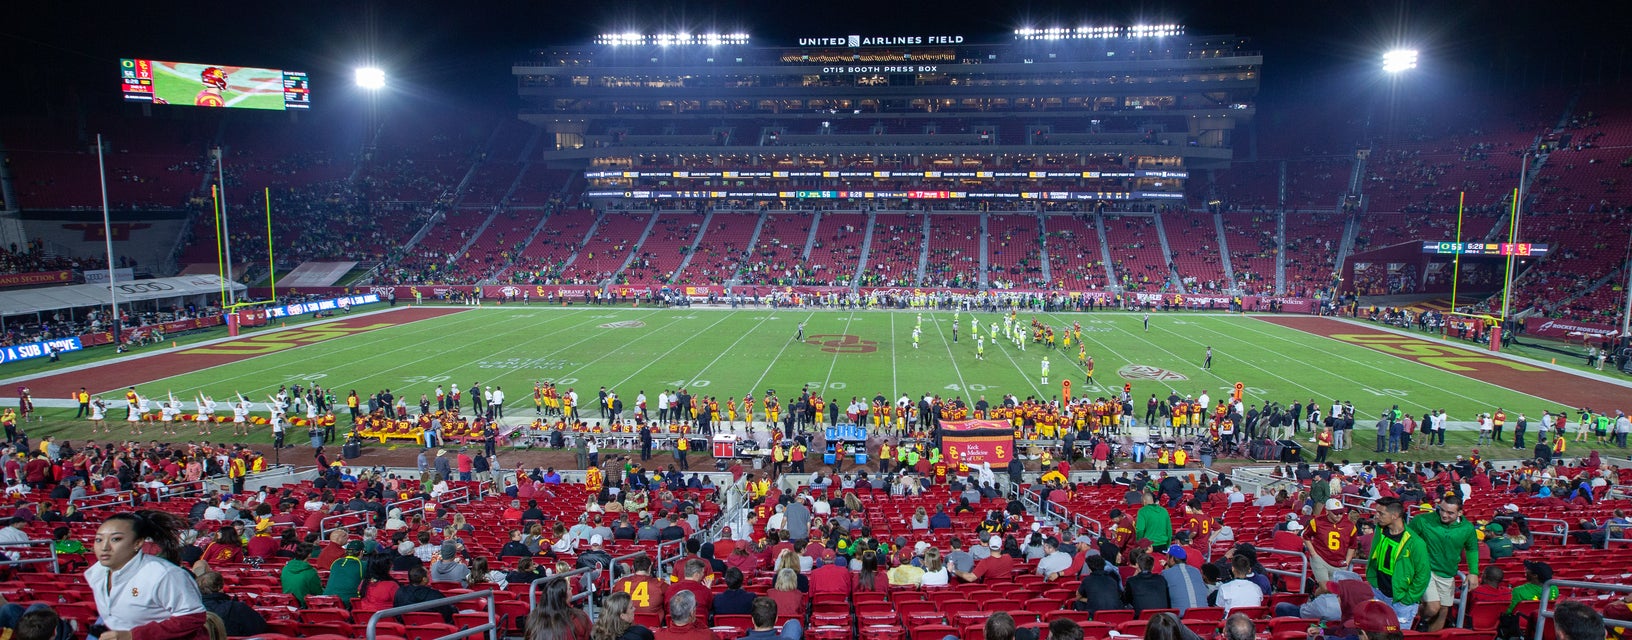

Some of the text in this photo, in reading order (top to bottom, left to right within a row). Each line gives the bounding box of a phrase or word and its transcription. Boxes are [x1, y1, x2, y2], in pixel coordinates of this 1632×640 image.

[863, 37, 922, 45] AIRLINES
[928, 36, 964, 44] FIELD
[180, 322, 394, 356] USC
[8, 348, 17, 360] A
[18, 344, 41, 358] SUB
[1328, 334, 1549, 372] USC
[666, 380, 712, 388] 40
[806, 382, 846, 390] 50
[1362, 388, 1408, 396] 10
[682, 426, 687, 434] 7
[949, 446, 959, 459] SC
[995, 446, 1005, 458] SC
[960, 462, 968, 472] 55
[758, 510, 765, 518] 5
[986, 525, 995, 533] 7
[1202, 520, 1209, 534] 9
[1328, 531, 1341, 550] 6
[624, 581, 650, 607] 14
